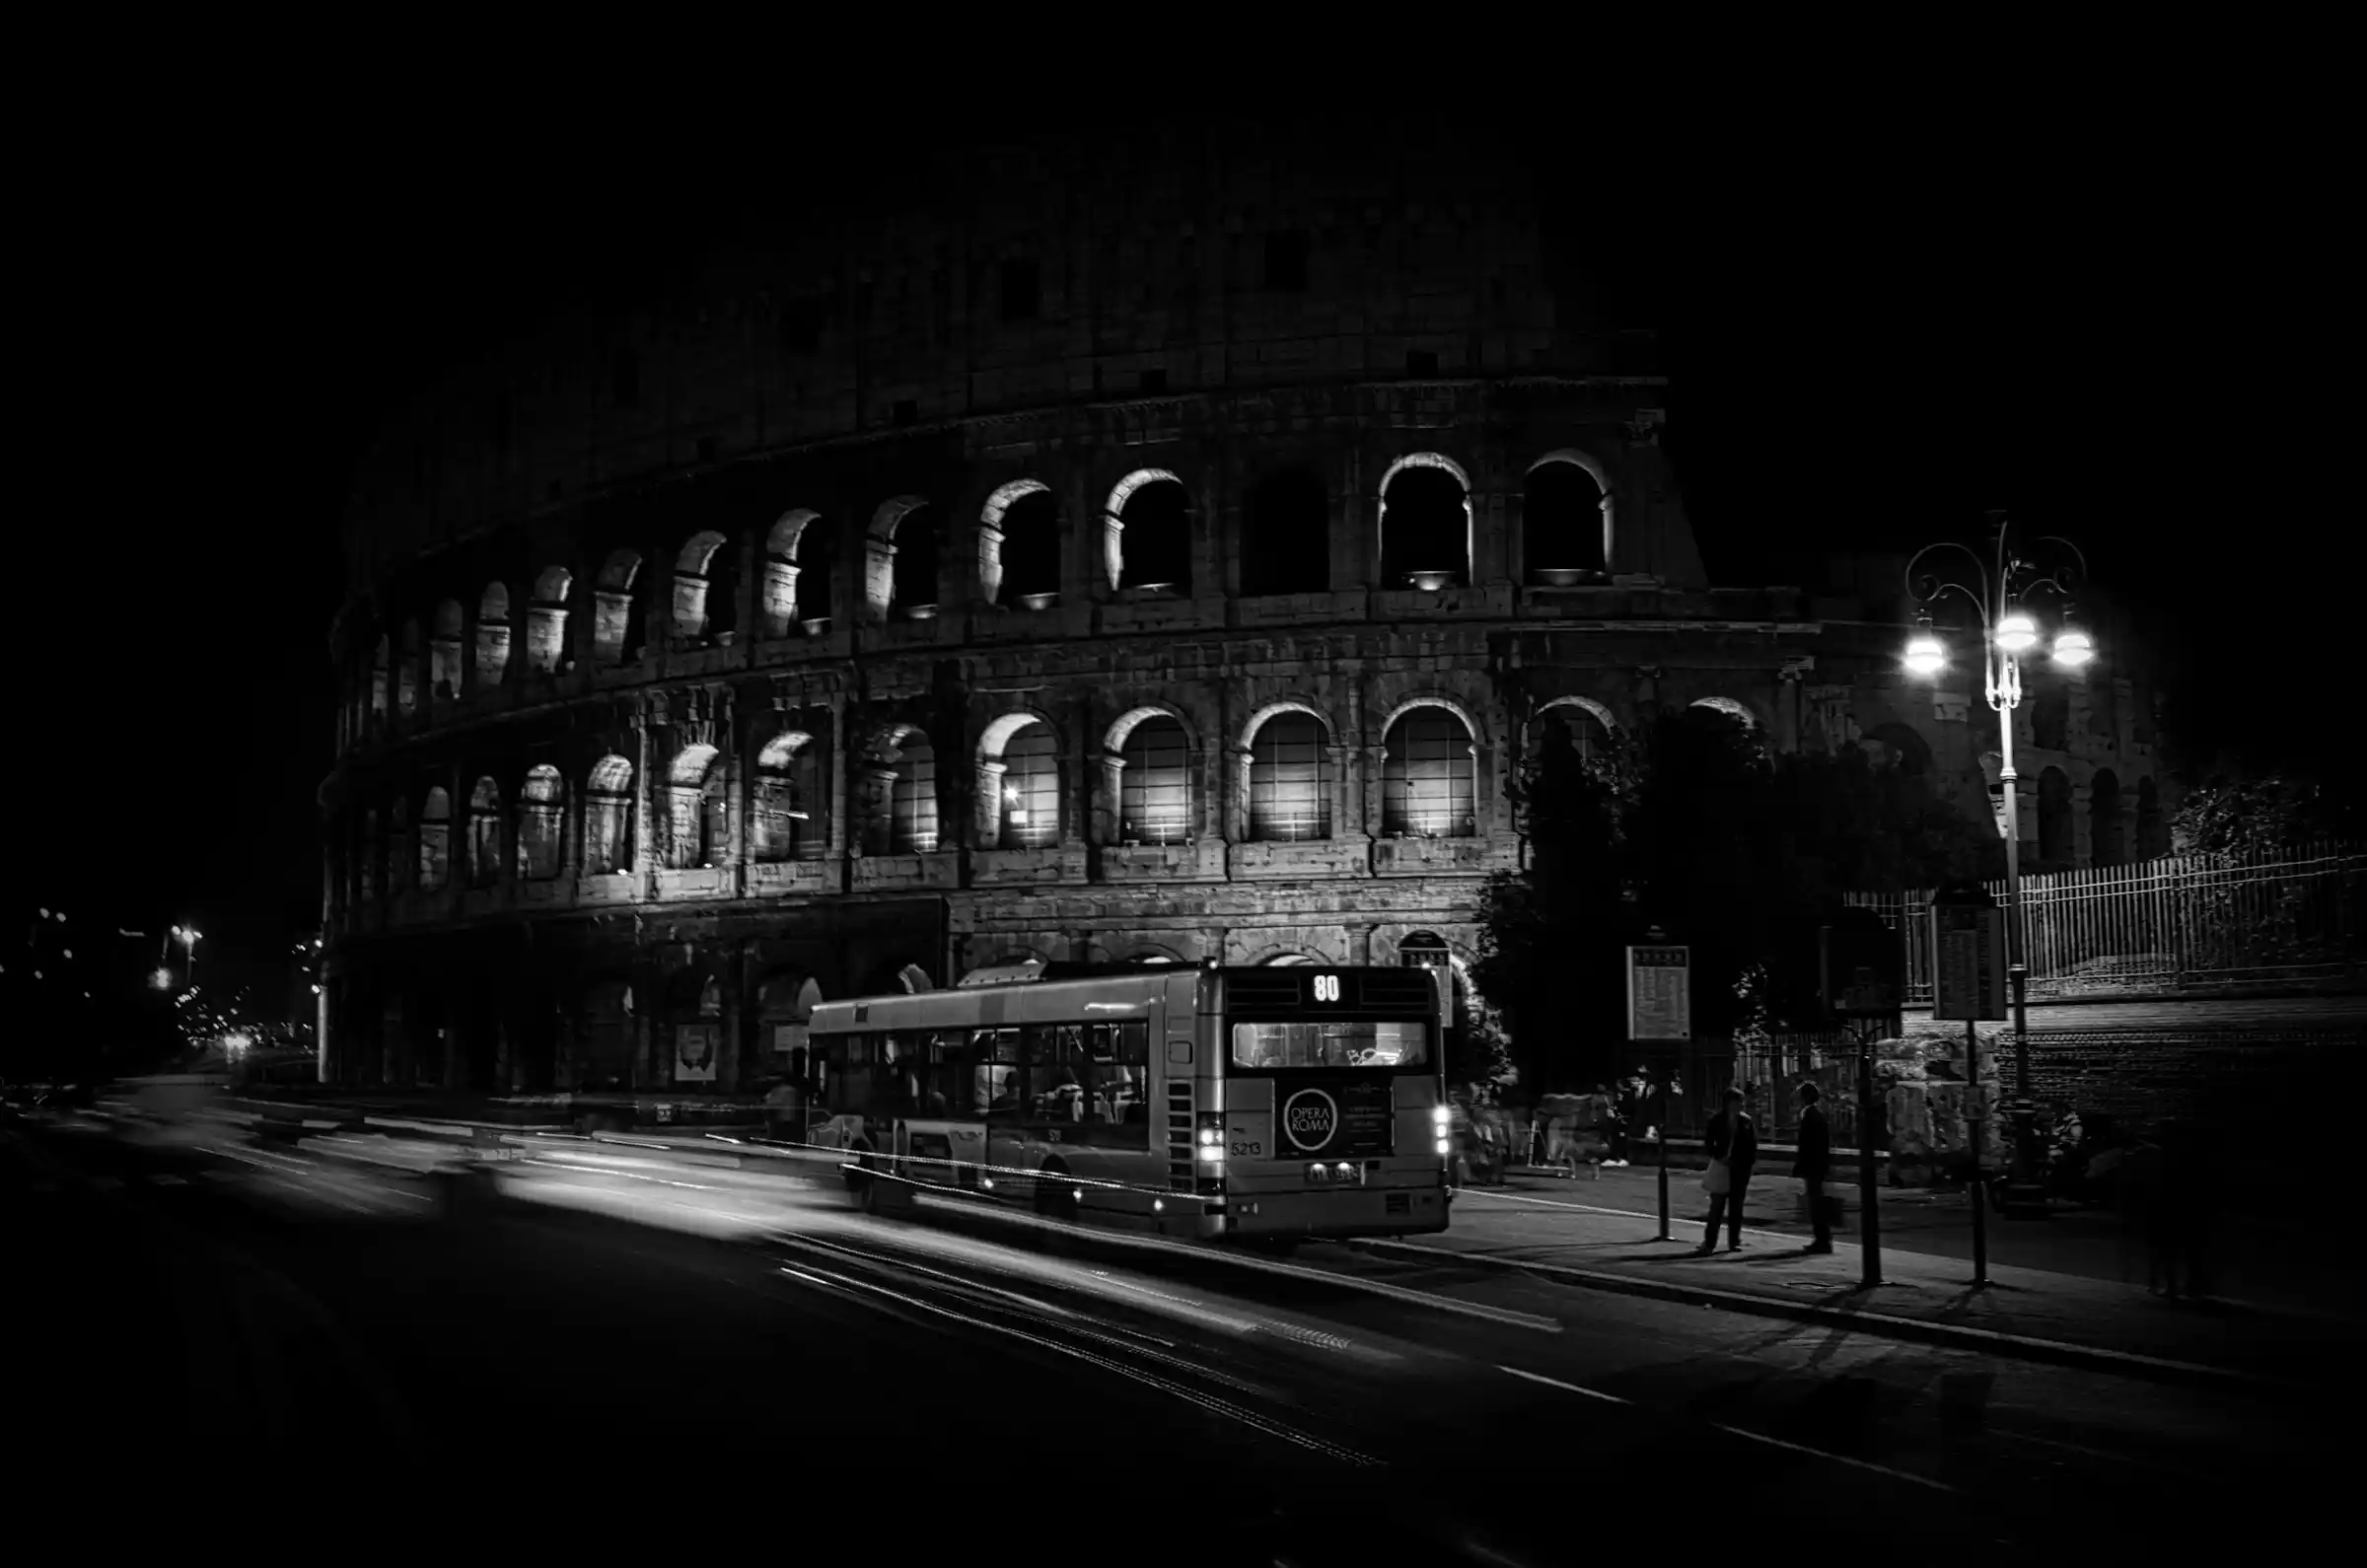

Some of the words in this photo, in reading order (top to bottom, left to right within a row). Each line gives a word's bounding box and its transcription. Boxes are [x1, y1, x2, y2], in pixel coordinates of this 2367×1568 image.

[1314, 974, 1339, 1001] 80
[1291, 1107, 1329, 1120] OPERA
[1292, 1119, 1329, 1133] ROMA
[1232, 1142, 1260, 1156] 5213
